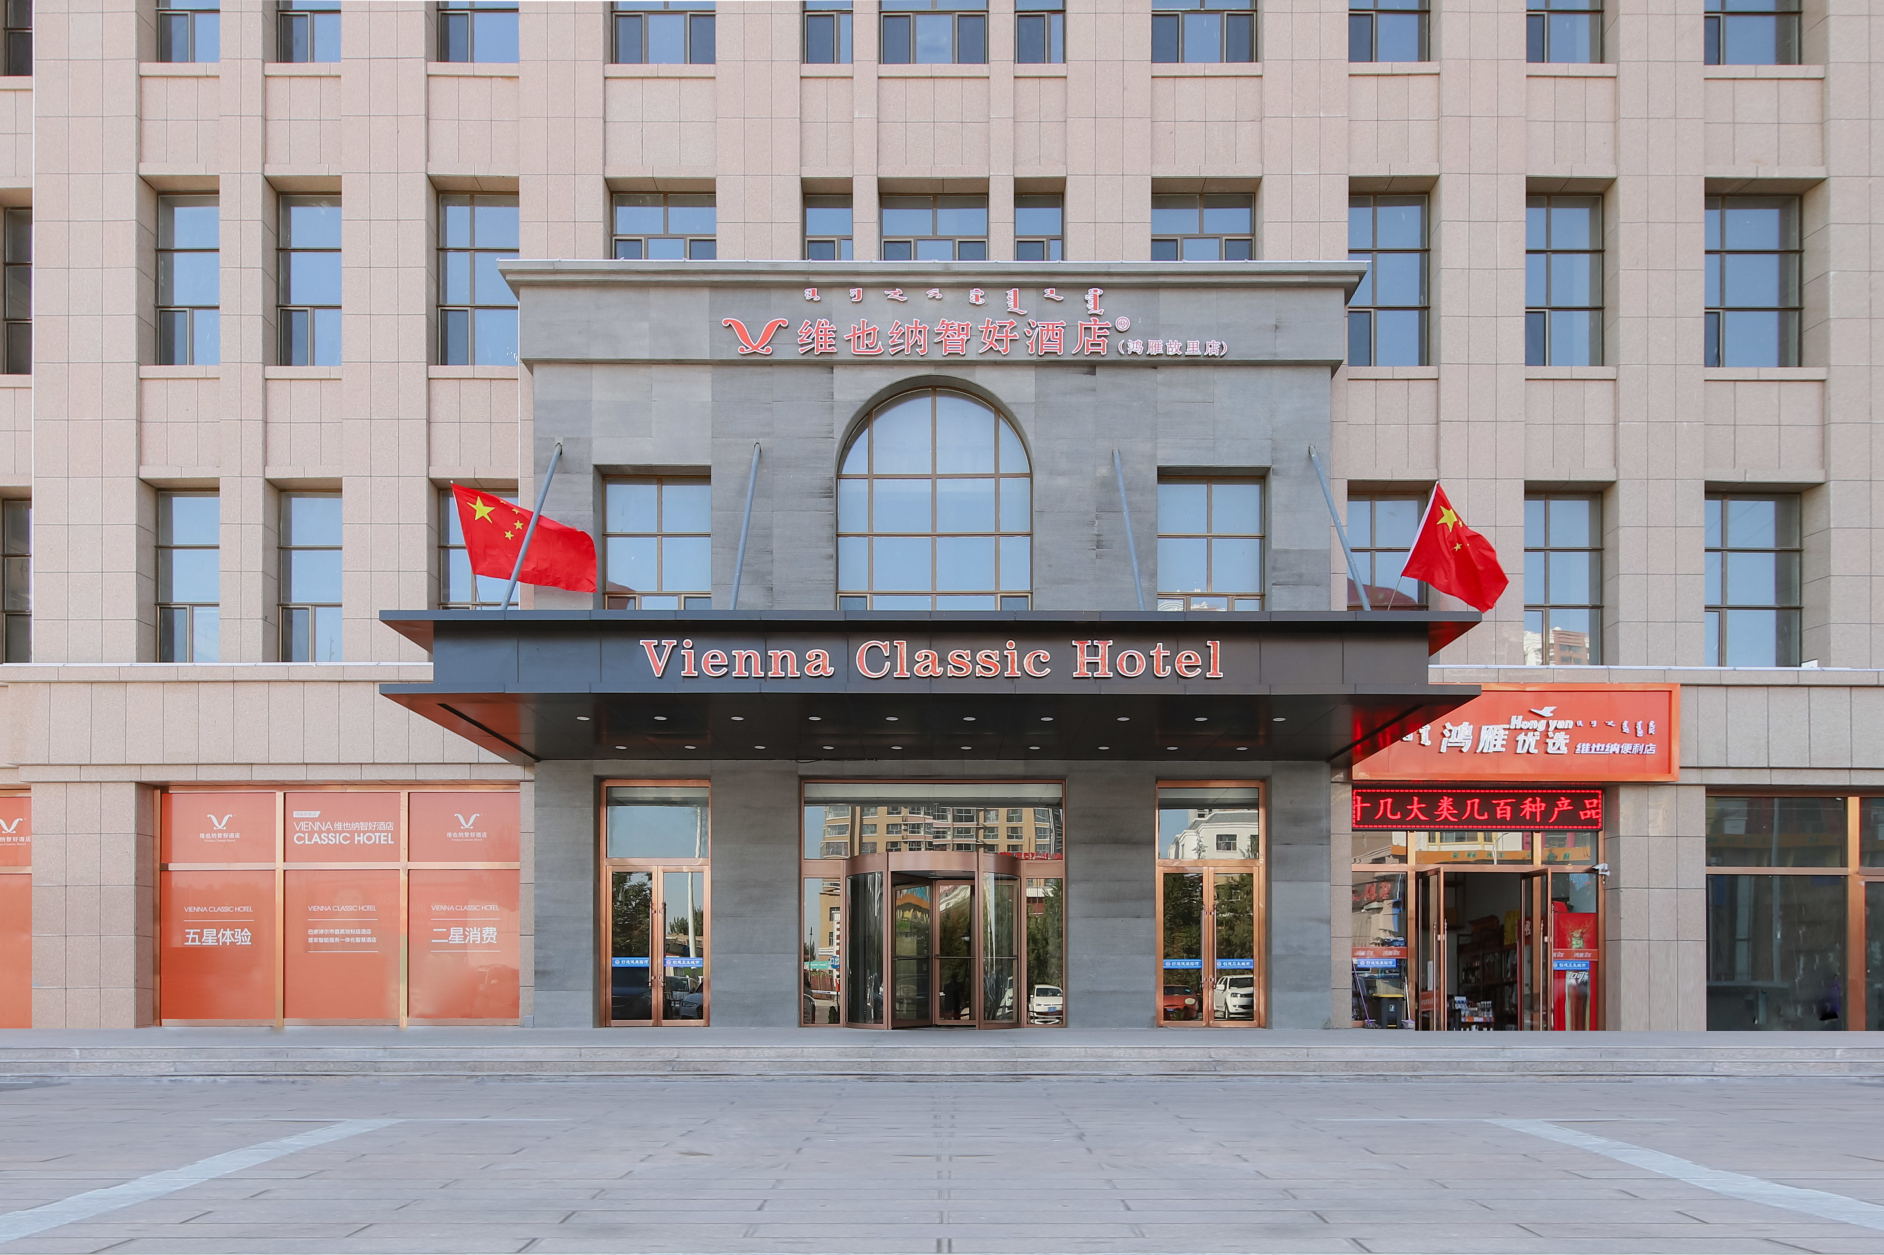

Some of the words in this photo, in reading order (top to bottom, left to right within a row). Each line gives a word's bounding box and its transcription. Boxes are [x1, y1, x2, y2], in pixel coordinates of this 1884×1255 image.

[797, 318, 1112, 356] 维也纳智好酒店
[639, 639, 834, 678] Vienna
[856, 640, 1051, 678] Classic
[1072, 640, 1224, 678] Hotel
[1440, 722, 1570, 754] 鸿雁优选
[1575, 743, 1656, 754] 维也纳便利店
[293, 822, 333, 831] VIENNA
[293, 833, 351, 845] CLASSIC
[354, 833, 395, 844] HOTEL
[184, 928, 252, 946] 五星体验
[431, 927, 497, 944] 二星消费
